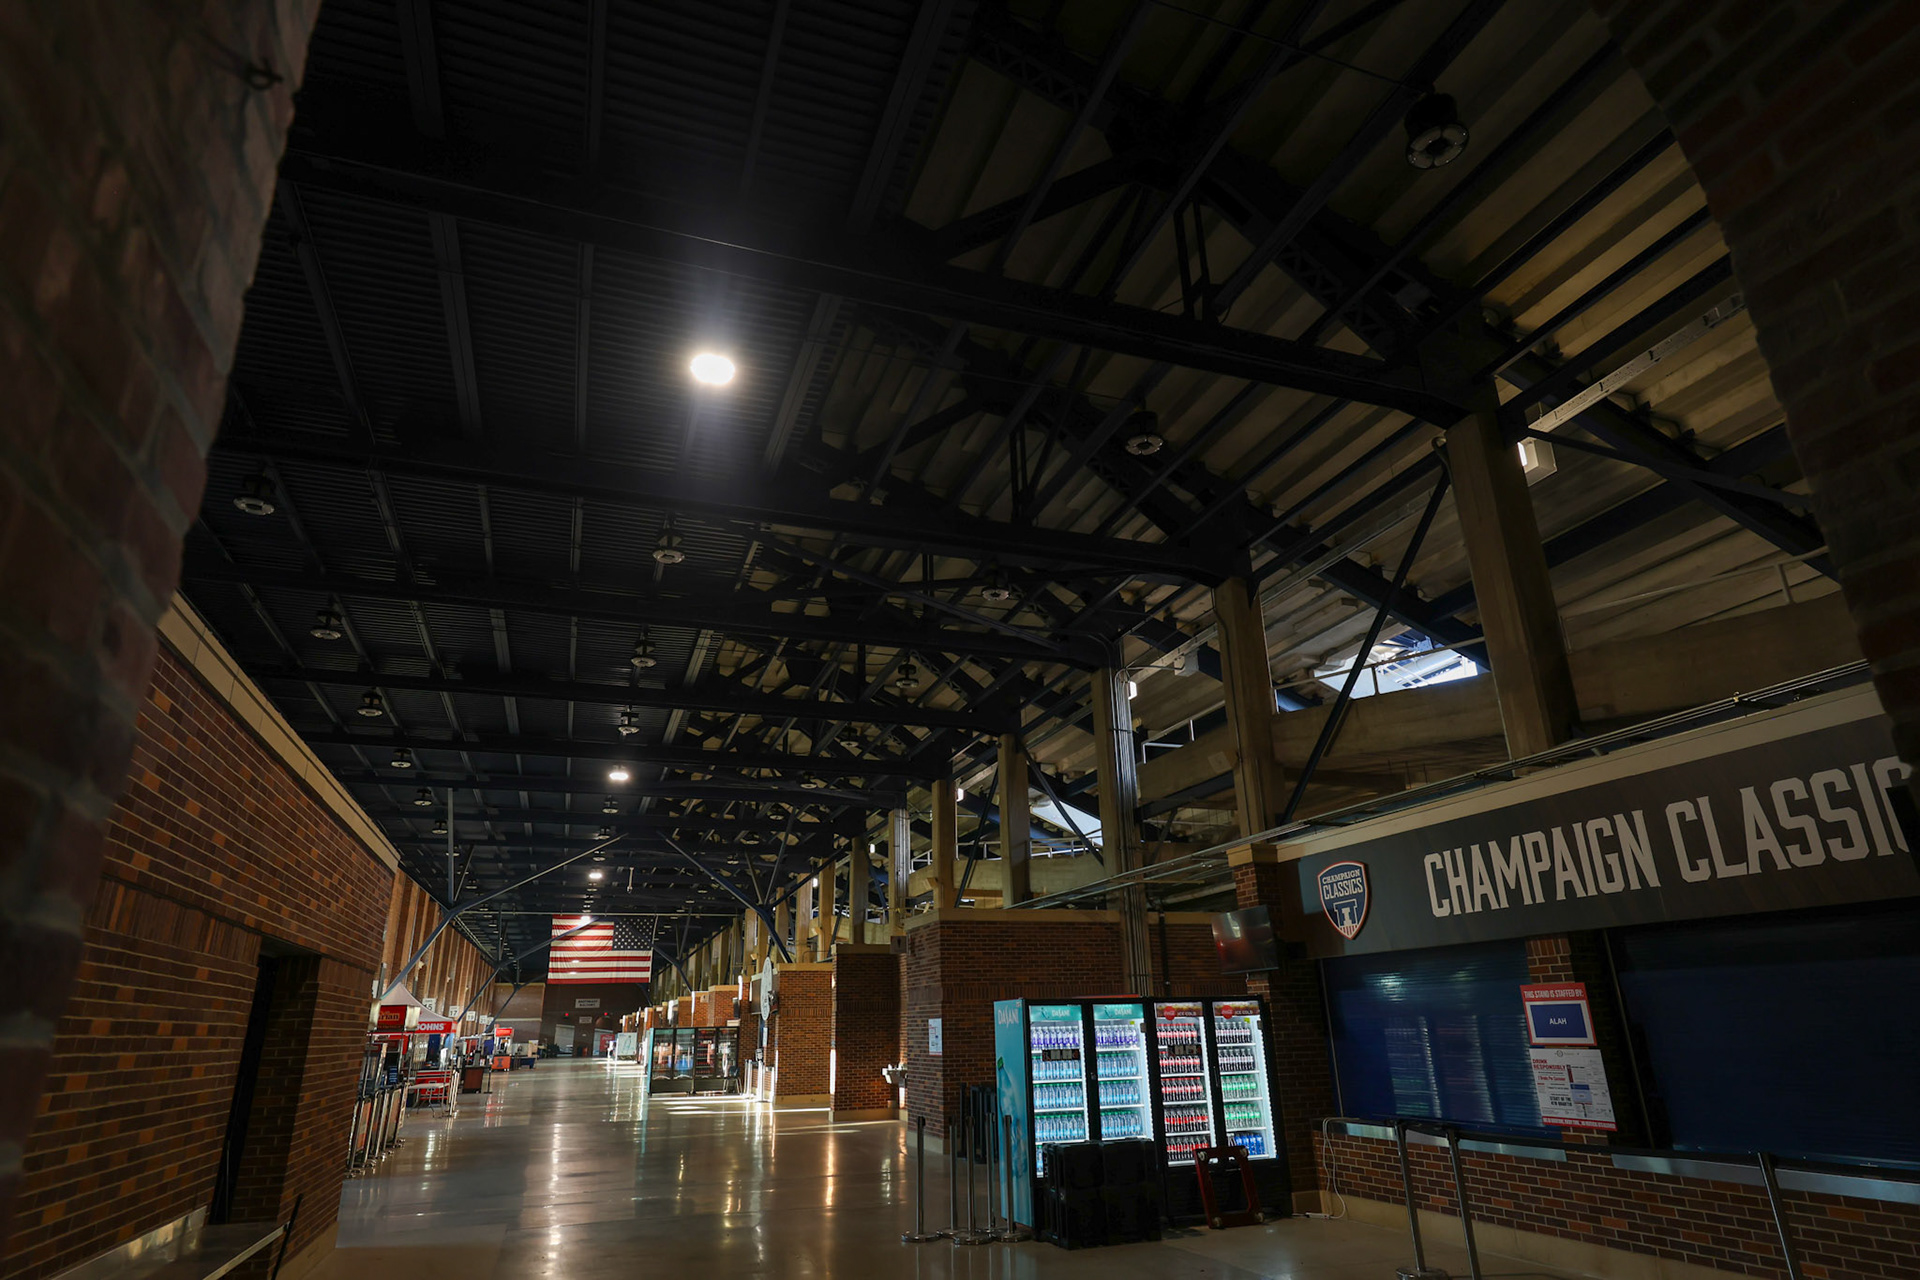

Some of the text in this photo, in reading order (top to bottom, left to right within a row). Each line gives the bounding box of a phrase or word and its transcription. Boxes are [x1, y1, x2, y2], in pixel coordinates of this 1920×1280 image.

[1423, 810, 1660, 917] CHAMPAIGN
[1322, 869, 1361, 884] CHAMPAIGN
[1323, 877, 1364, 900] CLASSICS
[1524, 990, 1534, 998] THIS
[1535, 990, 1550, 998] STAND
[1549, 990, 1555, 998] IS
[1555, 989, 1575, 998] STAFFED
[998, 1006, 1019, 1028] DASANI
[1051, 1008, 1070, 1017] DASANI
